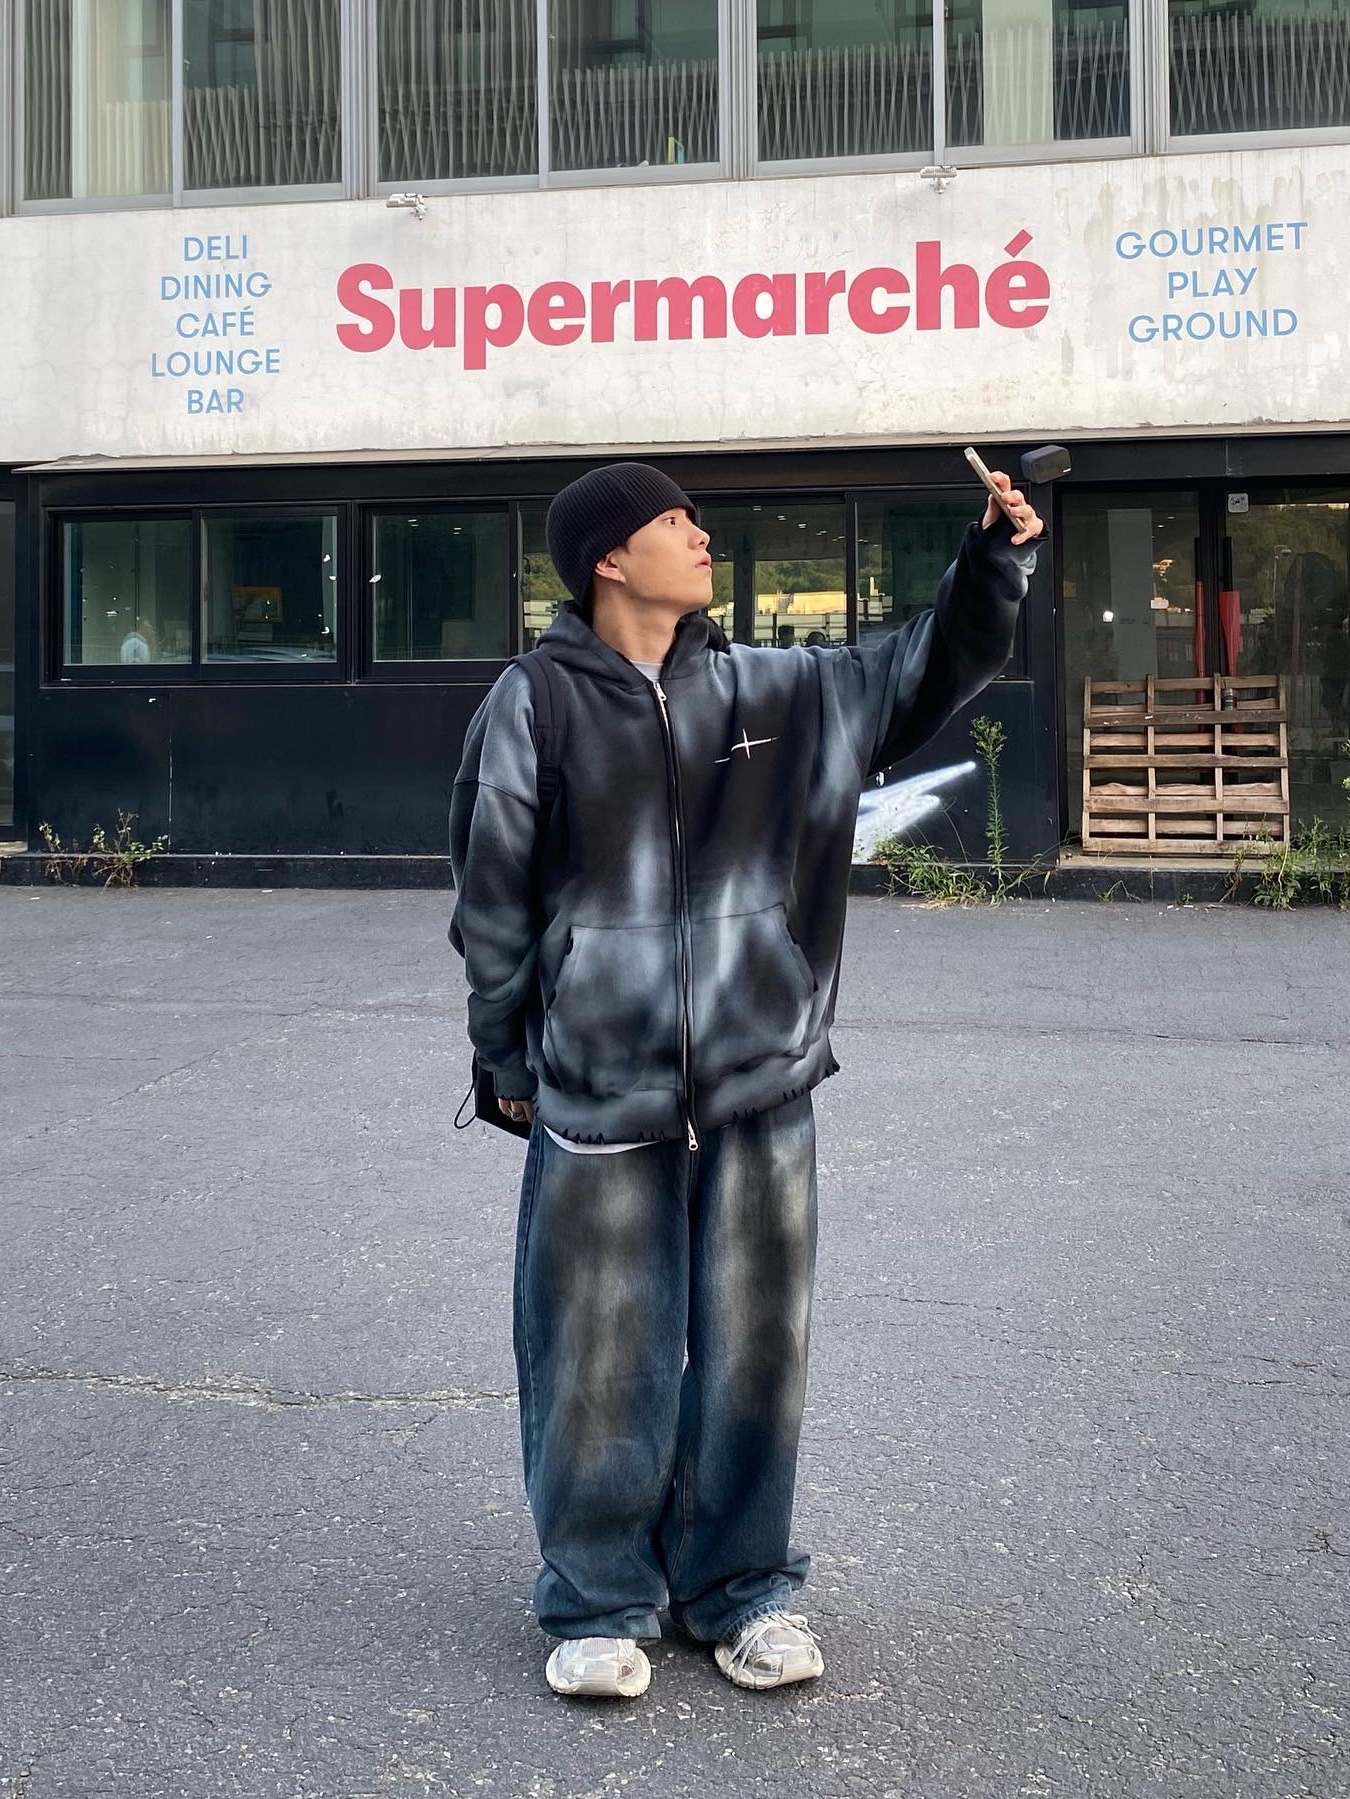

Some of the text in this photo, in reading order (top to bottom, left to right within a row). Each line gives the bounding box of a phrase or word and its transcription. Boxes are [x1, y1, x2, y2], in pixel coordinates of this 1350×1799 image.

[184, 235, 247, 261] DELI
[1116, 222, 1308, 260] GOURMET
[161, 272, 272, 301] DINING
[1168, 267, 1257, 298] PLAY
[336, 230, 1050, 369] Supermarché
[177, 306, 254, 338] CAFÉ
[1129, 308, 1298, 343] GROUND
[151, 349, 280, 377] LOUNGE
[187, 389, 244, 414] BAR
